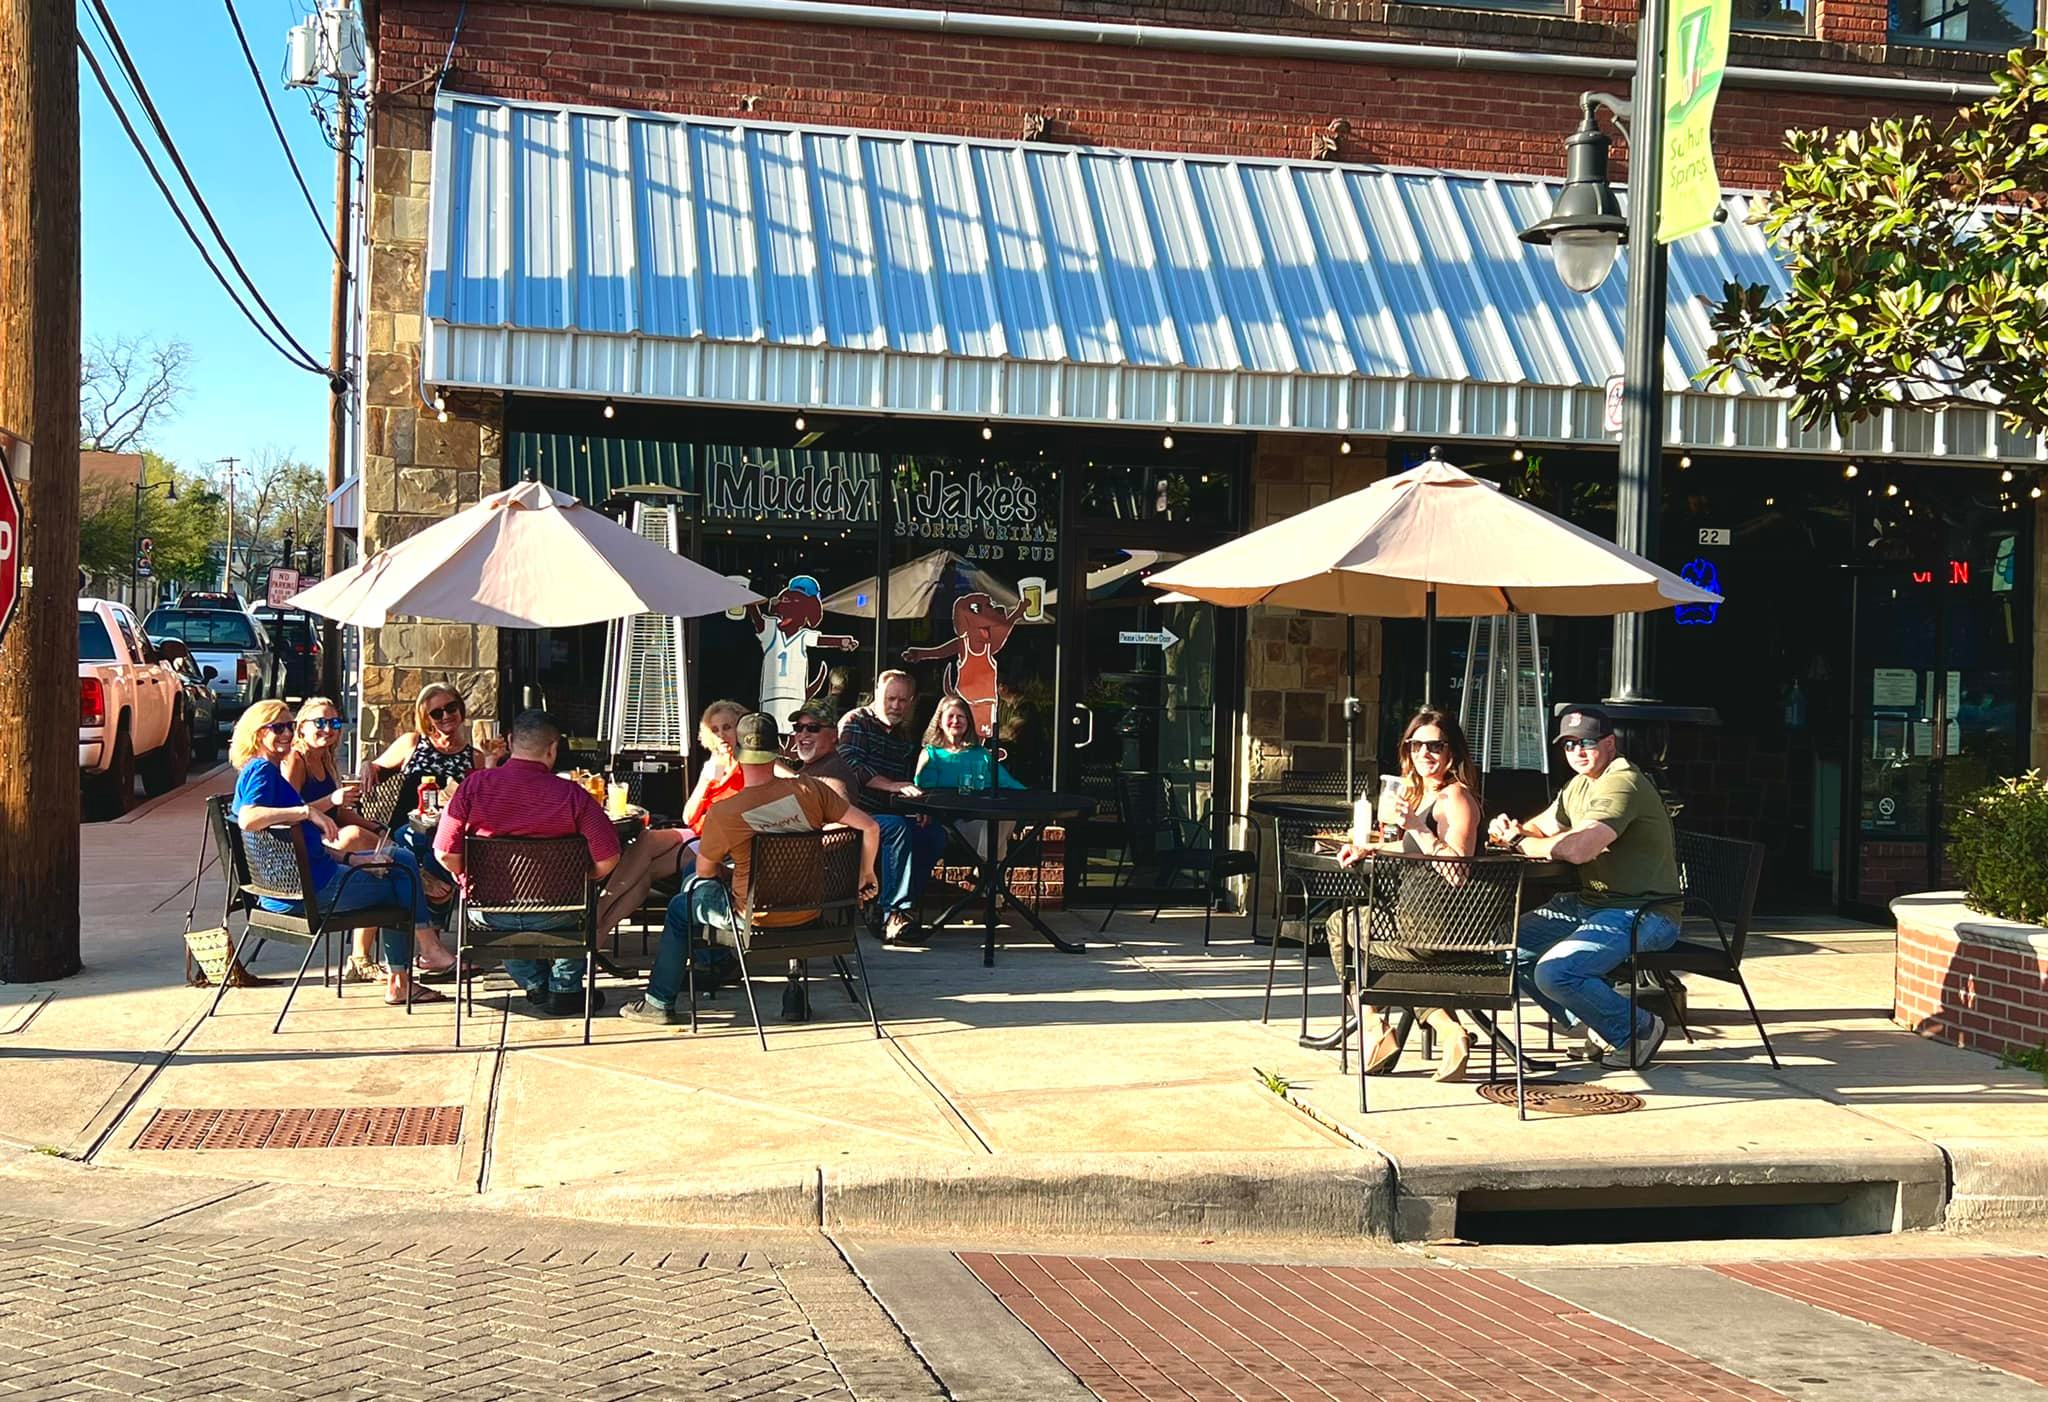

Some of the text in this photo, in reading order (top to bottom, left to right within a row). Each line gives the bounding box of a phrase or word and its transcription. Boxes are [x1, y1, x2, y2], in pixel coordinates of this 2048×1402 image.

[712, 462, 1038, 522] Muddy Jake's
[895, 521, 1058, 543] SPORTS GRILLE
[1701, 530, 1719, 543] 22
[966, 544, 1056, 562] AND PUB
[279, 573, 290, 581] NO
